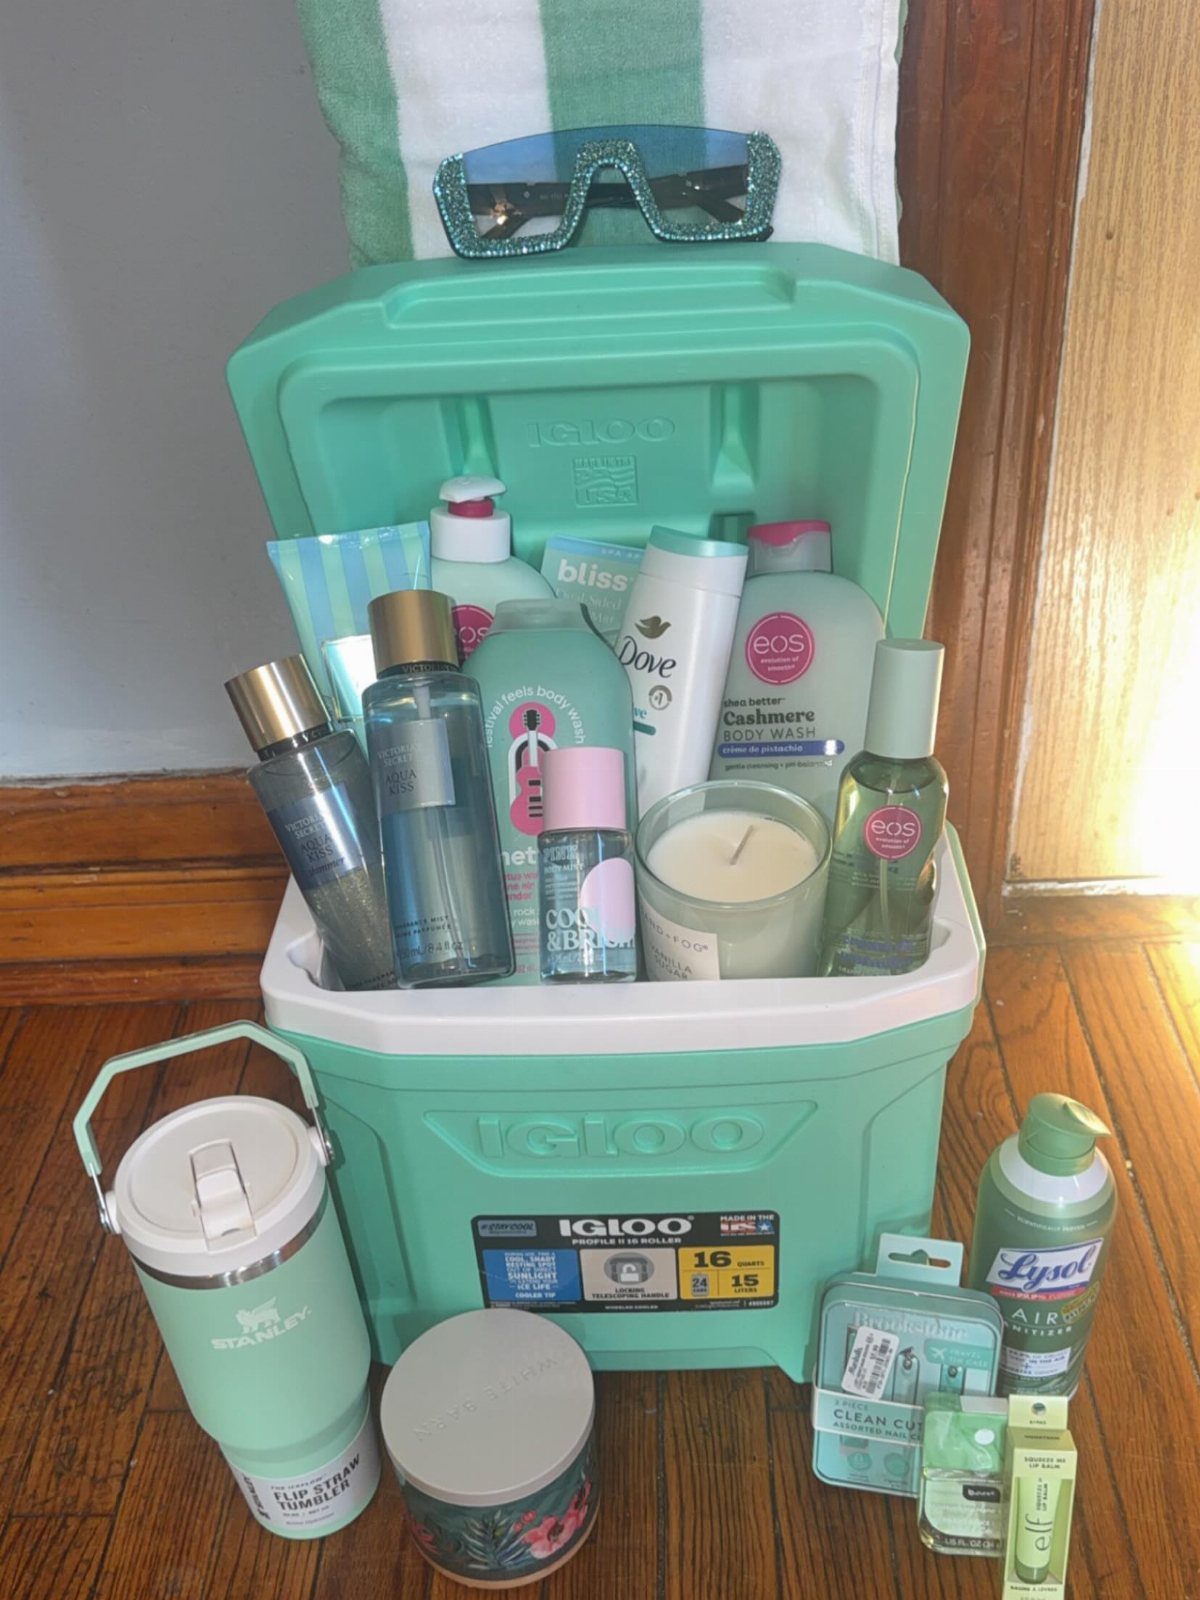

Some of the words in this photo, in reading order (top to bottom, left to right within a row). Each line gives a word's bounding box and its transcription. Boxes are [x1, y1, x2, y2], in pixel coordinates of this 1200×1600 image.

[527, 416, 675, 447] IGLOO
[557, 558, 629, 592] bliss
[753, 634, 805, 655] eos
[618, 635, 677, 678] Dove
[723, 698, 747, 707] shea
[748, 696, 782, 706] better
[501, 686, 534, 705] feels
[536, 685, 570, 709] body
[567, 707, 587, 744] wash
[722, 708, 815, 726] Cashmere
[723, 729, 764, 741] BODY
[769, 726, 817, 740] WASH
[760, 744, 803, 754] pistachio
[385, 769, 417, 784] AQUA
[388, 782, 415, 796] KISS
[871, 819, 916, 837] eos
[299, 834, 334, 853] AQUA
[306, 847, 334, 864] KISS
[477, 1113, 765, 1159] IGLOO
[559, 1217, 692, 1238] IGLOO
[572, 1238, 617, 1247] PROFILE
[640, 1237, 682, 1245] ROLLER
[693, 1250, 732, 1269] 16
[998, 1244, 1097, 1290] Lysol
[508, 1272, 558, 1282] SUNLIGHT
[691, 1277, 708, 1288] 24
[731, 1274, 760, 1287] 15
[1011, 1307, 1059, 1325] AIR
[210, 1305, 308, 1350] STANLEY
[833, 1407, 887, 1427] CLEAN
[832, 1421, 882, 1435] ASSORTED
[884, 1429, 907, 1440] NAIL
[273, 1488, 308, 1502] FLIP
[312, 1452, 360, 1496] STRAW
[276, 1479, 351, 1511] TUMBLER
